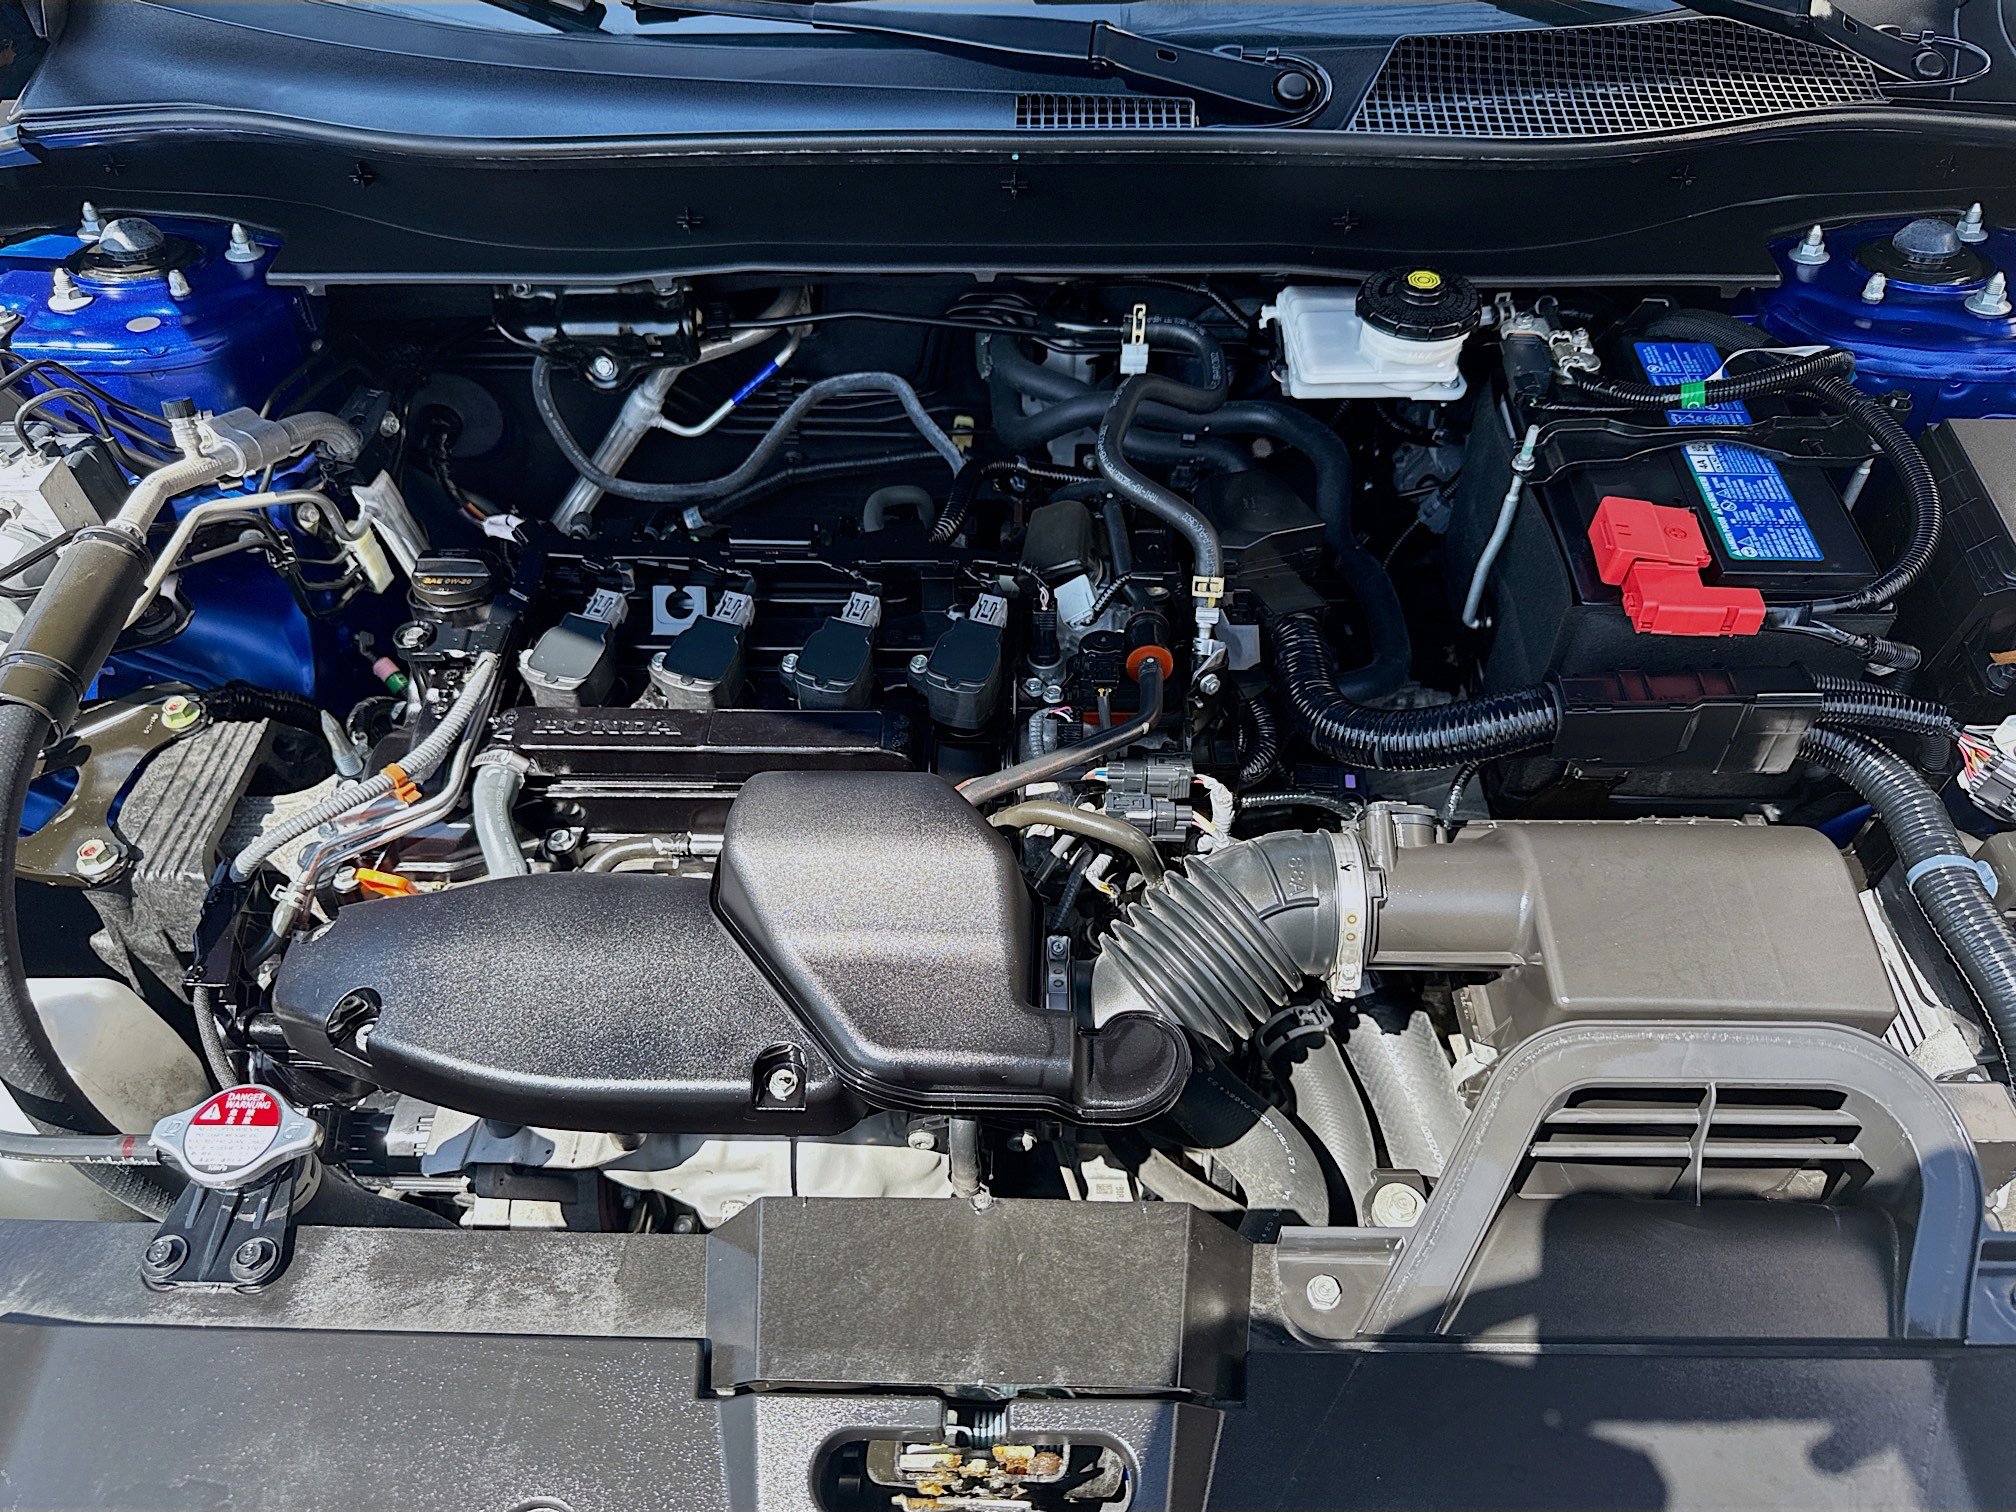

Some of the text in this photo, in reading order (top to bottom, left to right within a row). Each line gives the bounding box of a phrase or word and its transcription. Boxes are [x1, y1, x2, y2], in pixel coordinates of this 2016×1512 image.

[531, 718, 682, 736] HONDA
[228, 1092, 266, 1101] DANGER
[225, 1100, 271, 1110] WARNUNG
